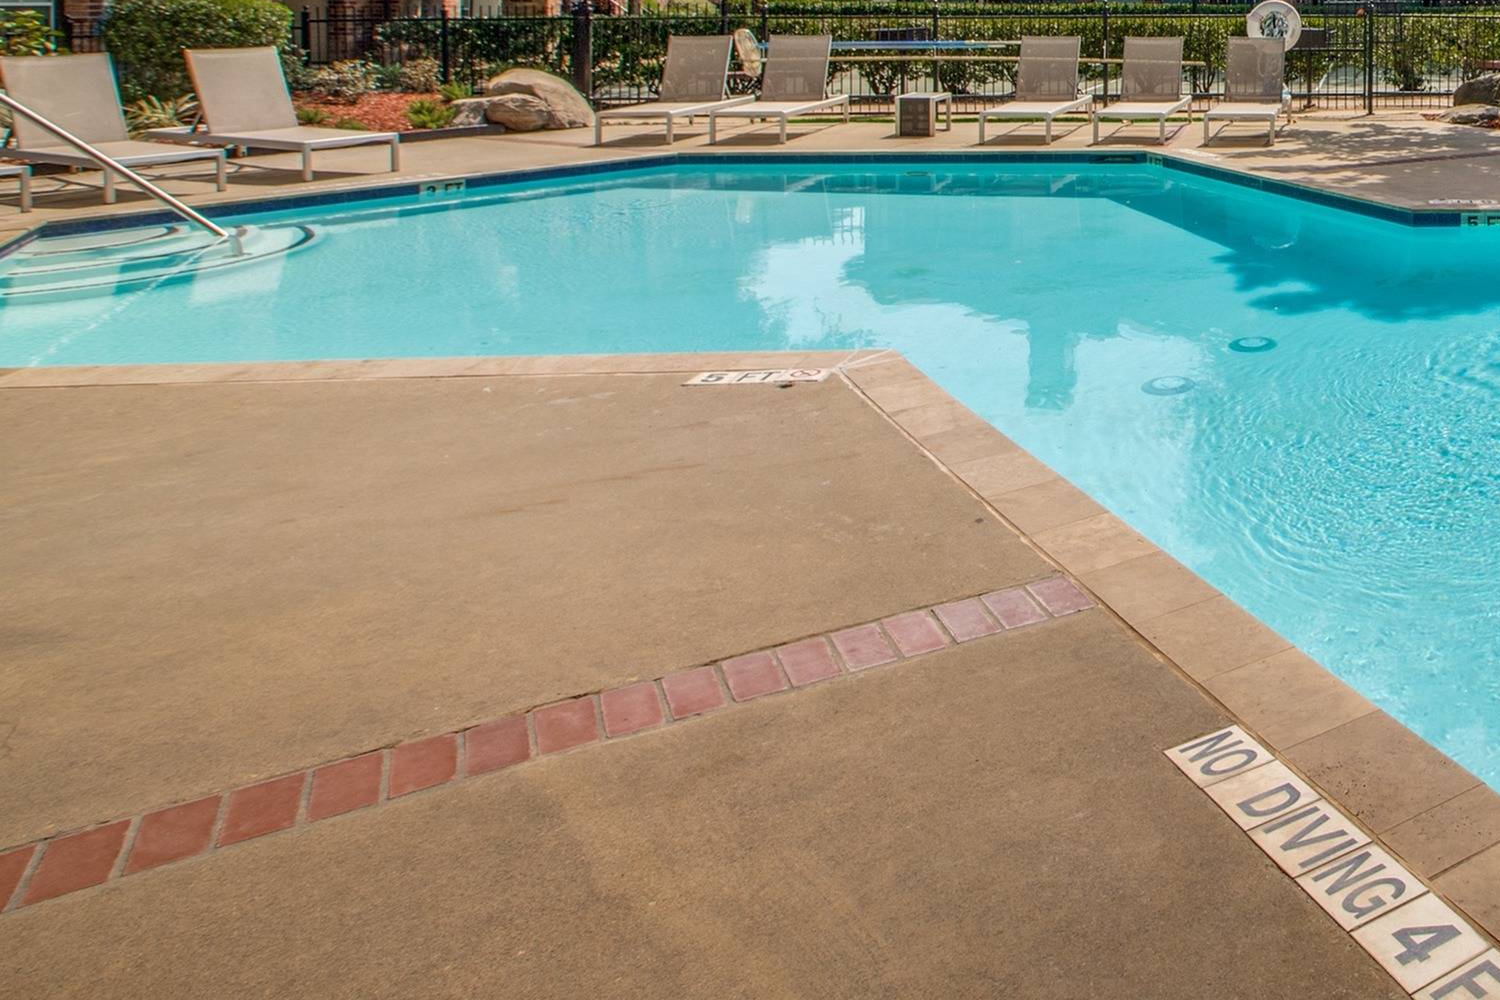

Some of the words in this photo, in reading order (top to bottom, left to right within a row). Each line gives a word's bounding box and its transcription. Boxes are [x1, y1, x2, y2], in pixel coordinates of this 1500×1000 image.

[1467, 216, 1478, 226] 5
[701, 373, 728, 383] 5
[736, 371, 781, 382] FT
[1178, 730, 1258, 776] NO
[1235, 782, 1407, 920] DIVING
[1390, 924, 1463, 967] 4
